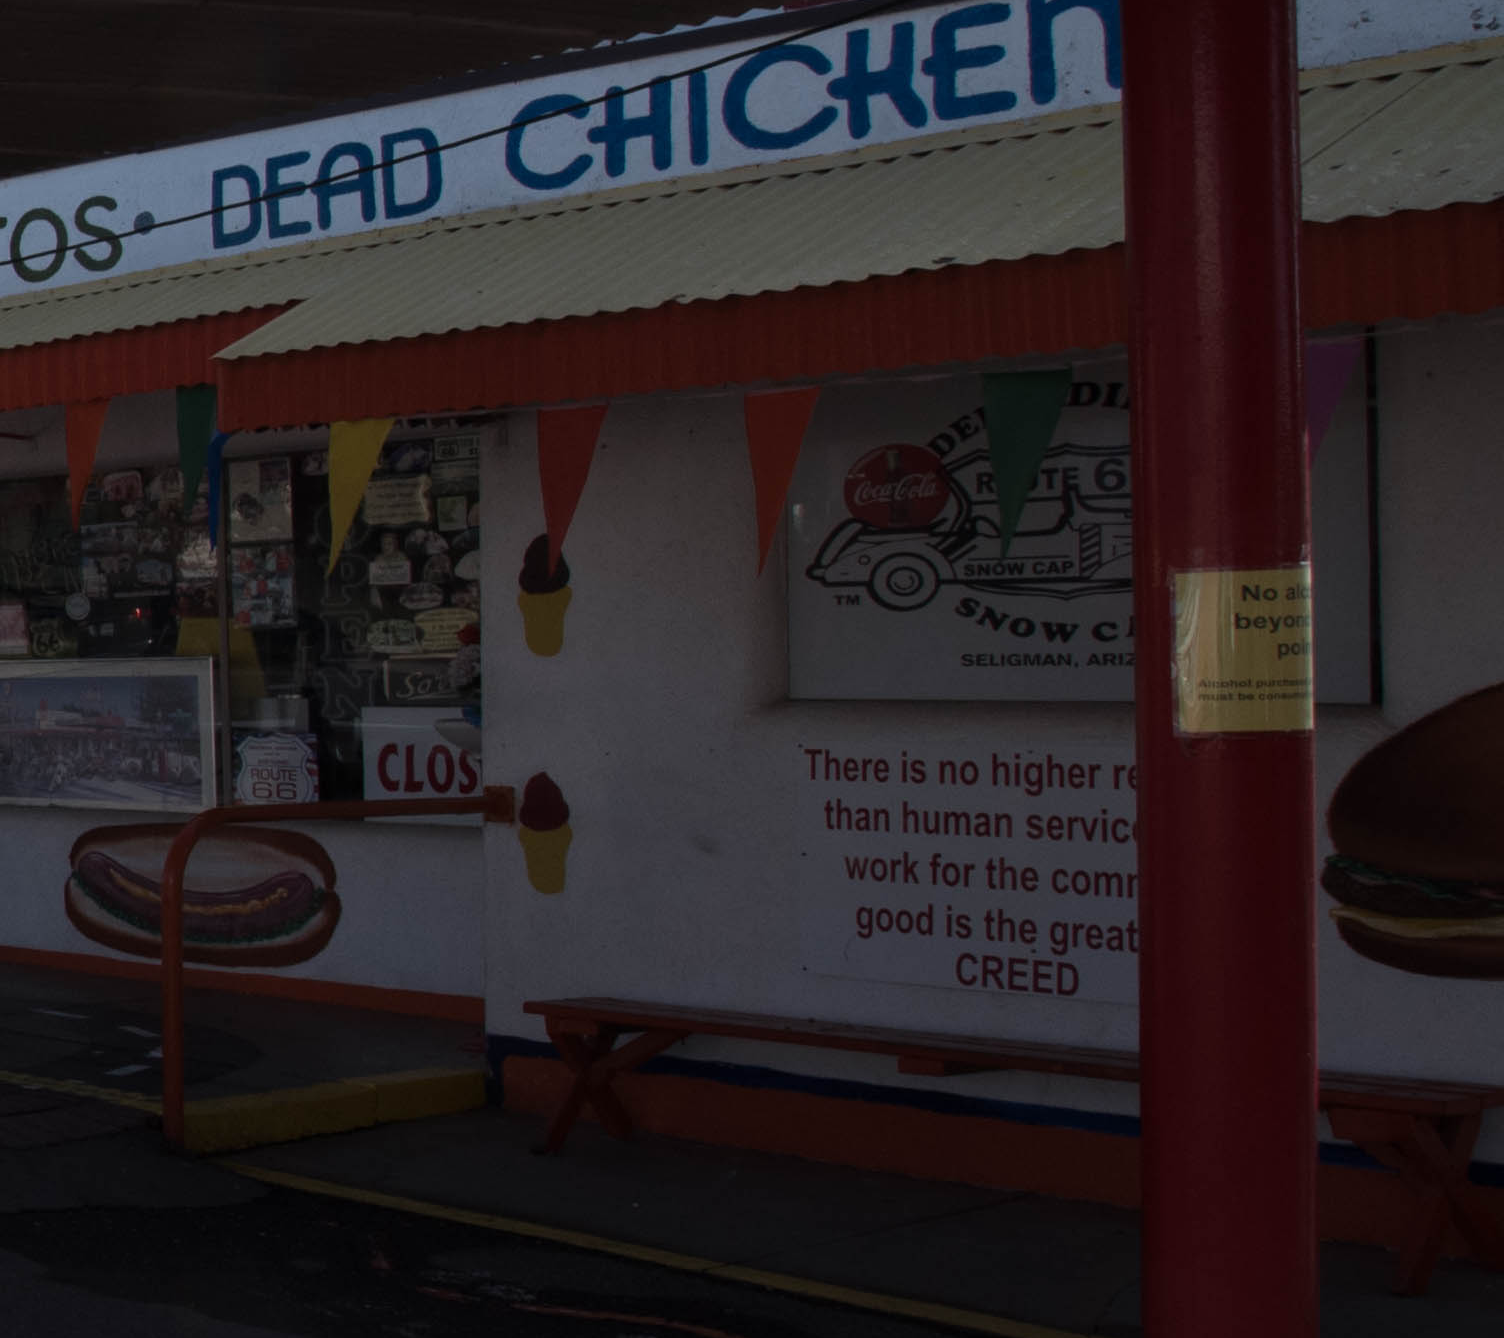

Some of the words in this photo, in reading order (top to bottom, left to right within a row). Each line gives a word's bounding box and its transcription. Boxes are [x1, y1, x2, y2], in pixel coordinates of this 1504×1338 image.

[212, 127, 443, 249] DEAD
[975, 467, 1079, 495] RTE
[1094, 458, 1126, 493] 6
[963, 561, 1029, 577] SNOW
[1033, 560, 1075, 575] CAP
[834, 594, 861, 607] TM
[1242, 585, 1279, 602] No
[1285, 583, 1311, 602] alc
[954, 597, 1080, 644] SNOW
[1234, 612, 1312, 634] beyon
[960, 653, 1080, 669] SELIGMAN,
[1087, 653, 1136, 668] ARIZ
[1277, 640, 1312, 660] poi
[1238, 691, 1255, 701] be
[250, 767, 297, 783] ROUTE
[377, 742, 479, 795] CLOS
[804, 748, 891, 783] There
[901, 750, 927, 784] is
[938, 759, 980, 786] no
[991, 753, 1101, 796] higher
[1112, 763, 1138, 791] re
[251, 781, 298, 800] 66
[824, 798, 891, 833] than
[902, 801, 1014, 839] human
[844, 851, 920, 885] work
[929, 853, 976, 888] for
[985, 856, 1039, 892] the
[1051, 868, 1138, 899] com
[856, 903, 935, 940] good
[945, 904, 973, 940] is
[984, 908, 1038, 944] the
[1049, 919, 1138, 957] great
[955, 952, 1080, 997] CREED
